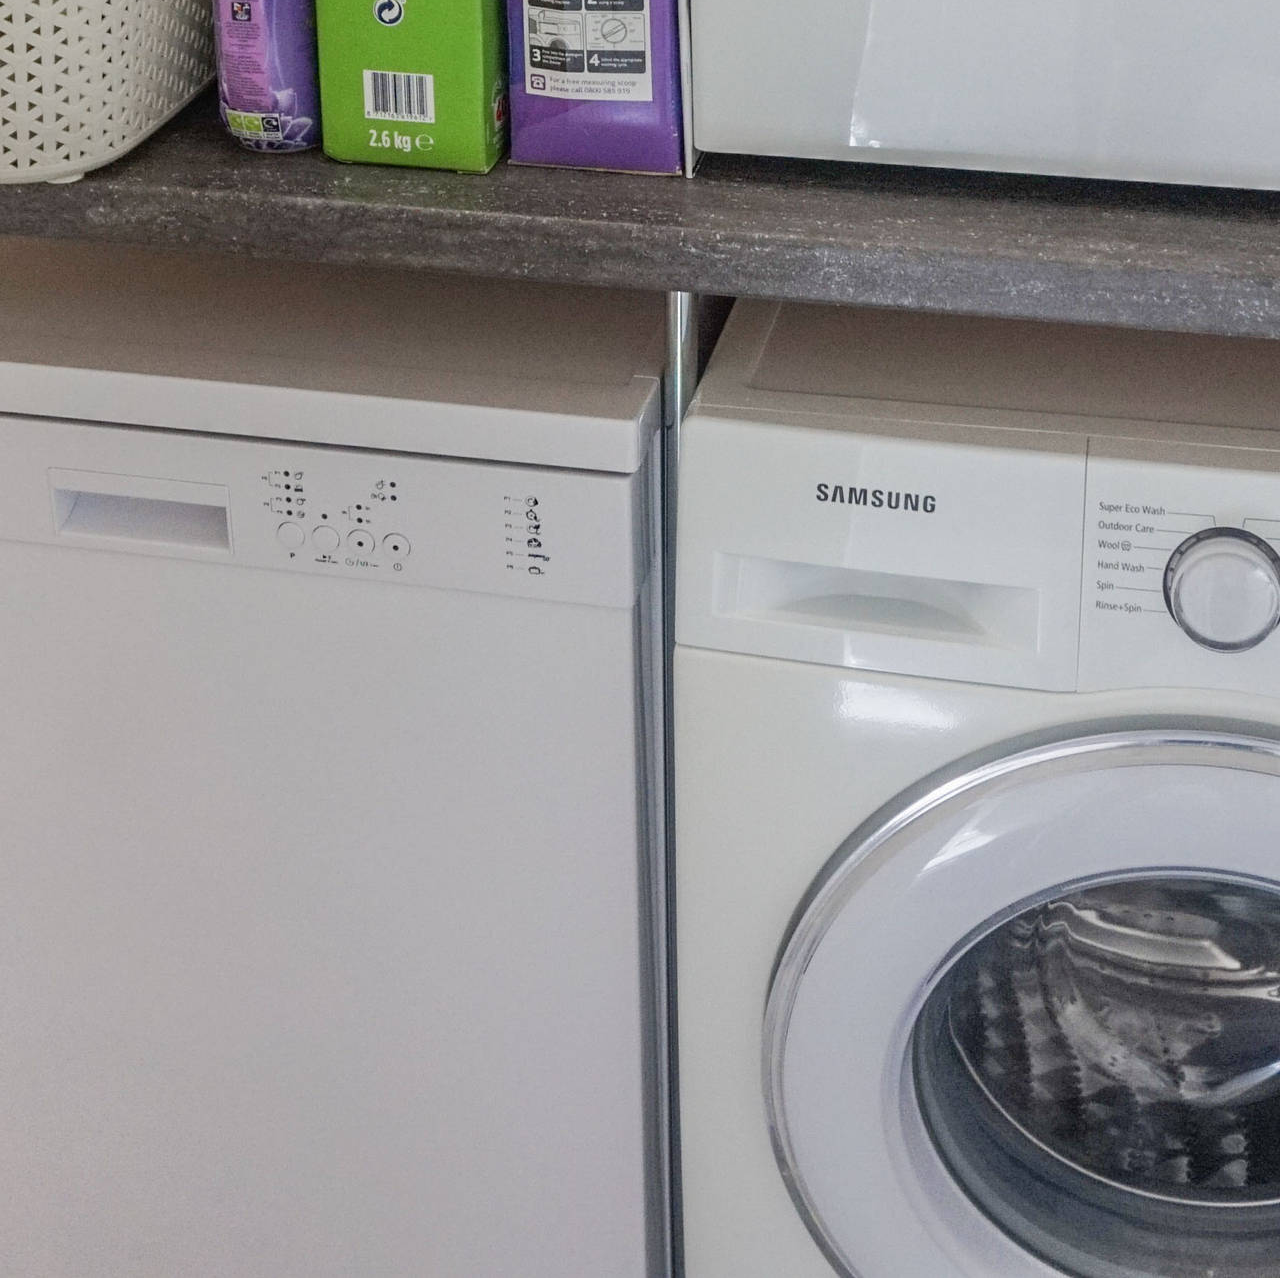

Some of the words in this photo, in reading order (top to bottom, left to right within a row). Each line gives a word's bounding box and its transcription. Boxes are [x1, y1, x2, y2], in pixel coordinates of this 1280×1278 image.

[532, 49, 541, 62] 3
[589, 53, 601, 67] 4
[369, 129, 391, 148] 2.6
[394, 131, 411, 152] kg
[816, 483, 936, 513] SAMSUNG
[1099, 502, 1122, 513] Super
[1125, 504, 1140, 514] Eco
[1142, 506, 1166, 515] Wash
[1098, 520, 1132, 532] Outdoor
[1135, 523, 1155, 533] Care
[1098, 539, 1120, 550] Wool
[1097, 561, 1119, 571] Hand
[1121, 562, 1145, 572] Wash
[1096, 580, 1114, 592] Spin
[1095, 601, 1142, 614] Rinse+Spin
